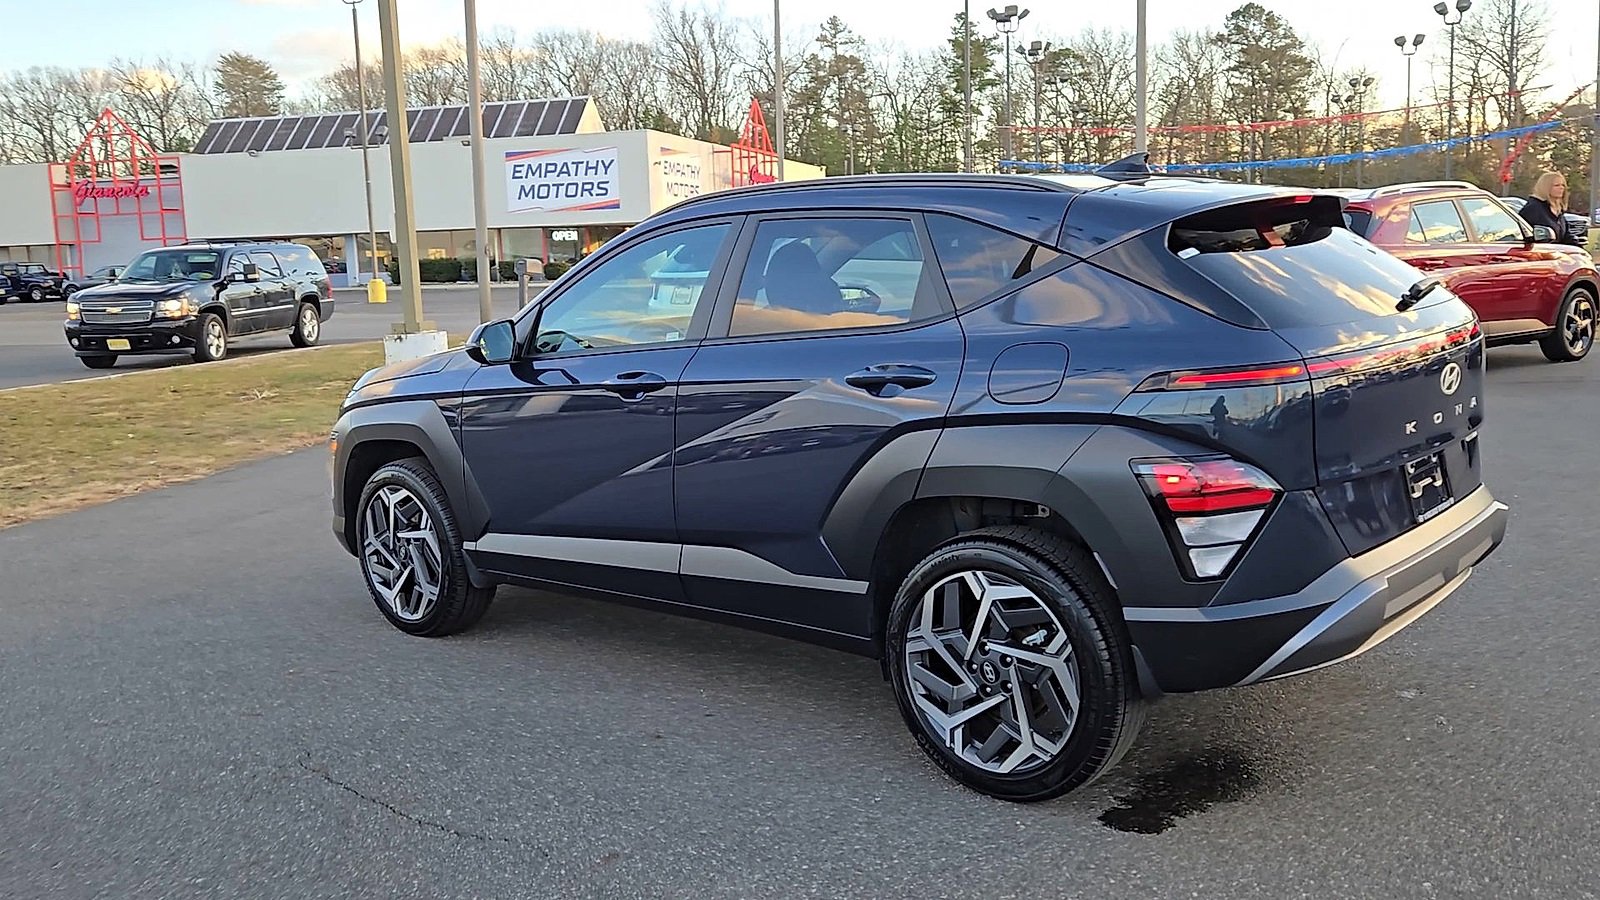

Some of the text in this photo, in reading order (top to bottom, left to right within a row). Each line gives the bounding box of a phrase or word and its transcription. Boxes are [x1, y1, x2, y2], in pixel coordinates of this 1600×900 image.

[511, 159, 615, 180] EMPATHY
[663, 160, 701, 179] EMPATHY
[517, 180, 610, 200] MOTORS
[666, 182, 700, 198] MOTORS
[551, 230, 579, 241] OPEN
[1404, 396, 1478, 436] KONA
